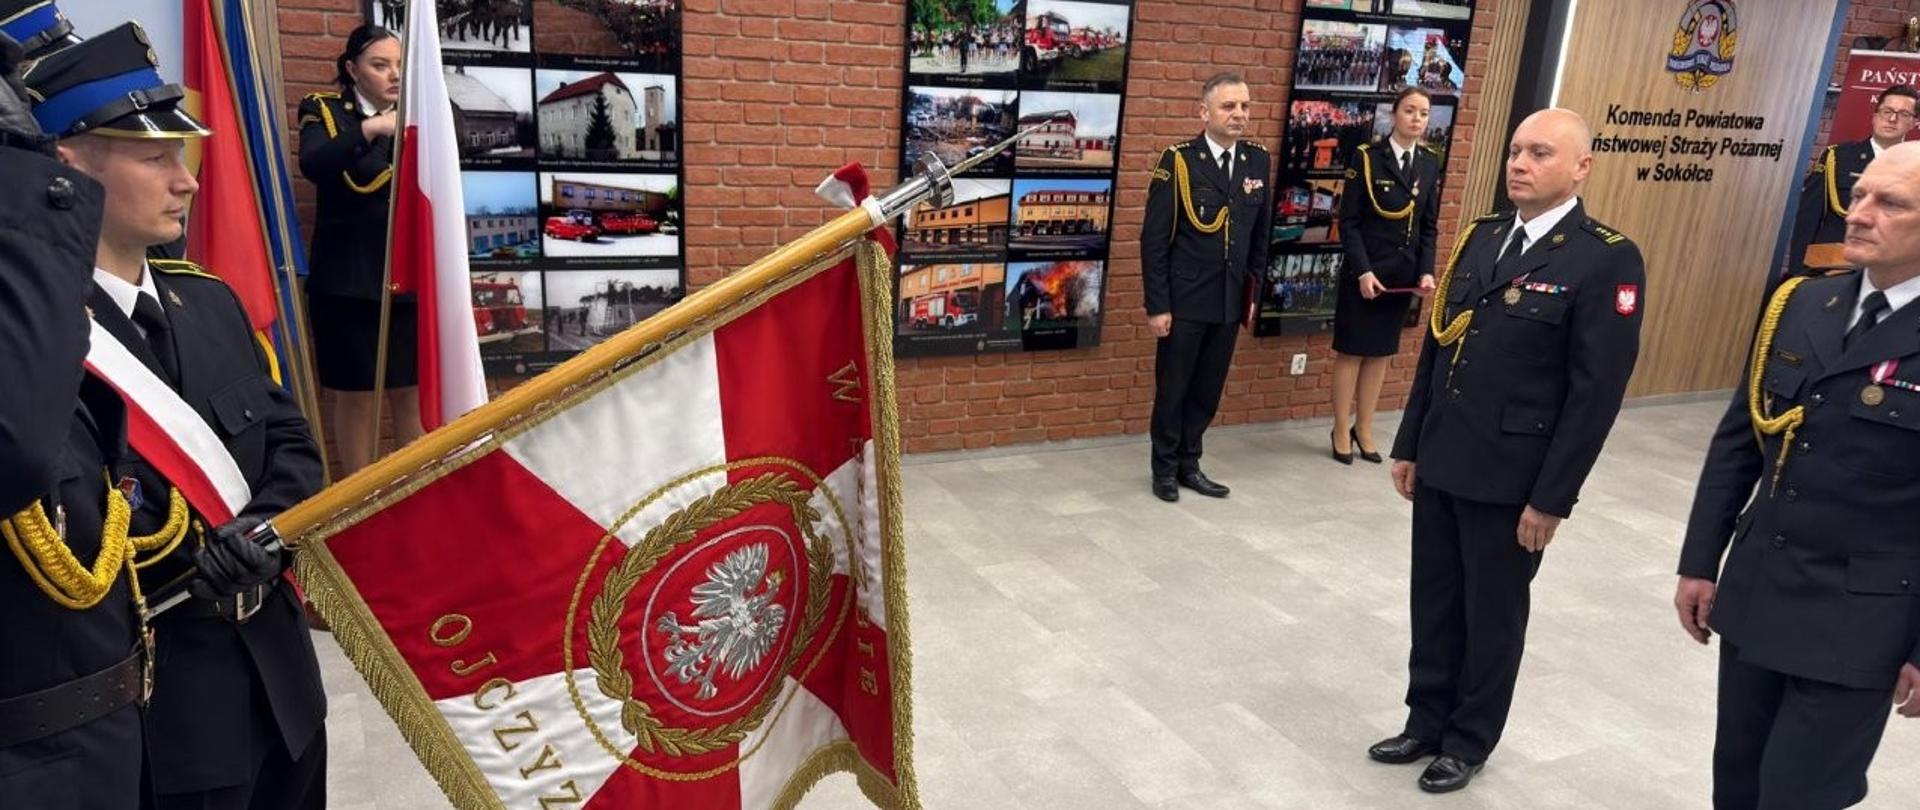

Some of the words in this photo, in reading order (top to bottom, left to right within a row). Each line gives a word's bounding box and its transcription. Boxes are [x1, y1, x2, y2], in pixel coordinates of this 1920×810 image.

[1861, 67, 1920, 86] PAŃST
[1606, 104, 1681, 127] Komenda
[1685, 109, 1765, 130] Powiatowa
[1591, 132, 1667, 159] ństwowej
[1670, 135, 1717, 161] Straży
[1720, 138, 1784, 162] Pożarnej
[1637, 166, 1650, 181] w
[1653, 163, 1714, 182] Sokółce
[827, 360, 862, 402] W
